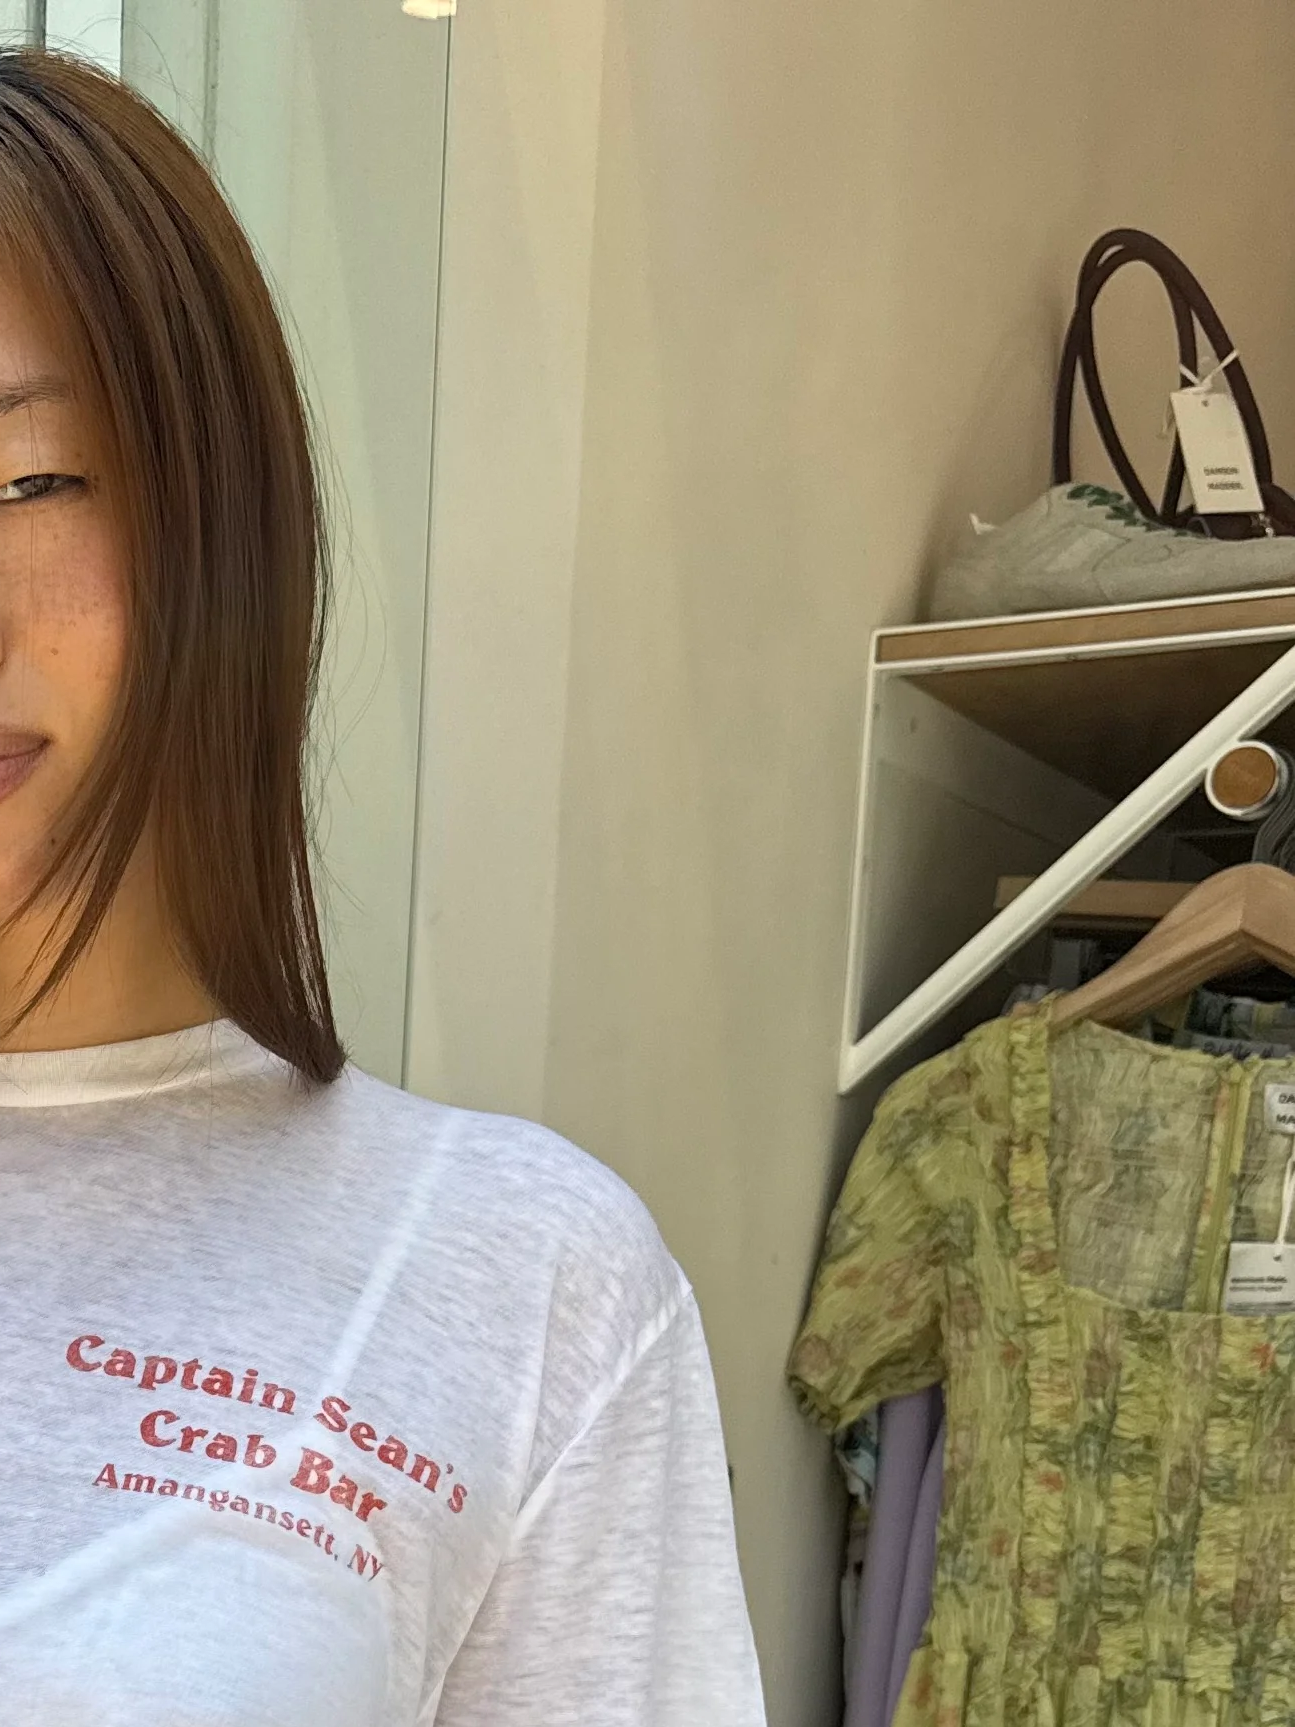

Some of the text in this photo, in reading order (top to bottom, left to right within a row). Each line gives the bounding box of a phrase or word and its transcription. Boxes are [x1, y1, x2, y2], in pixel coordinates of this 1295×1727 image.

[66, 1334, 468, 1514] Captain Sean's
[140, 1409, 387, 1522] Crab Bar
[92, 1463, 386, 1581] Amangansett, NY
